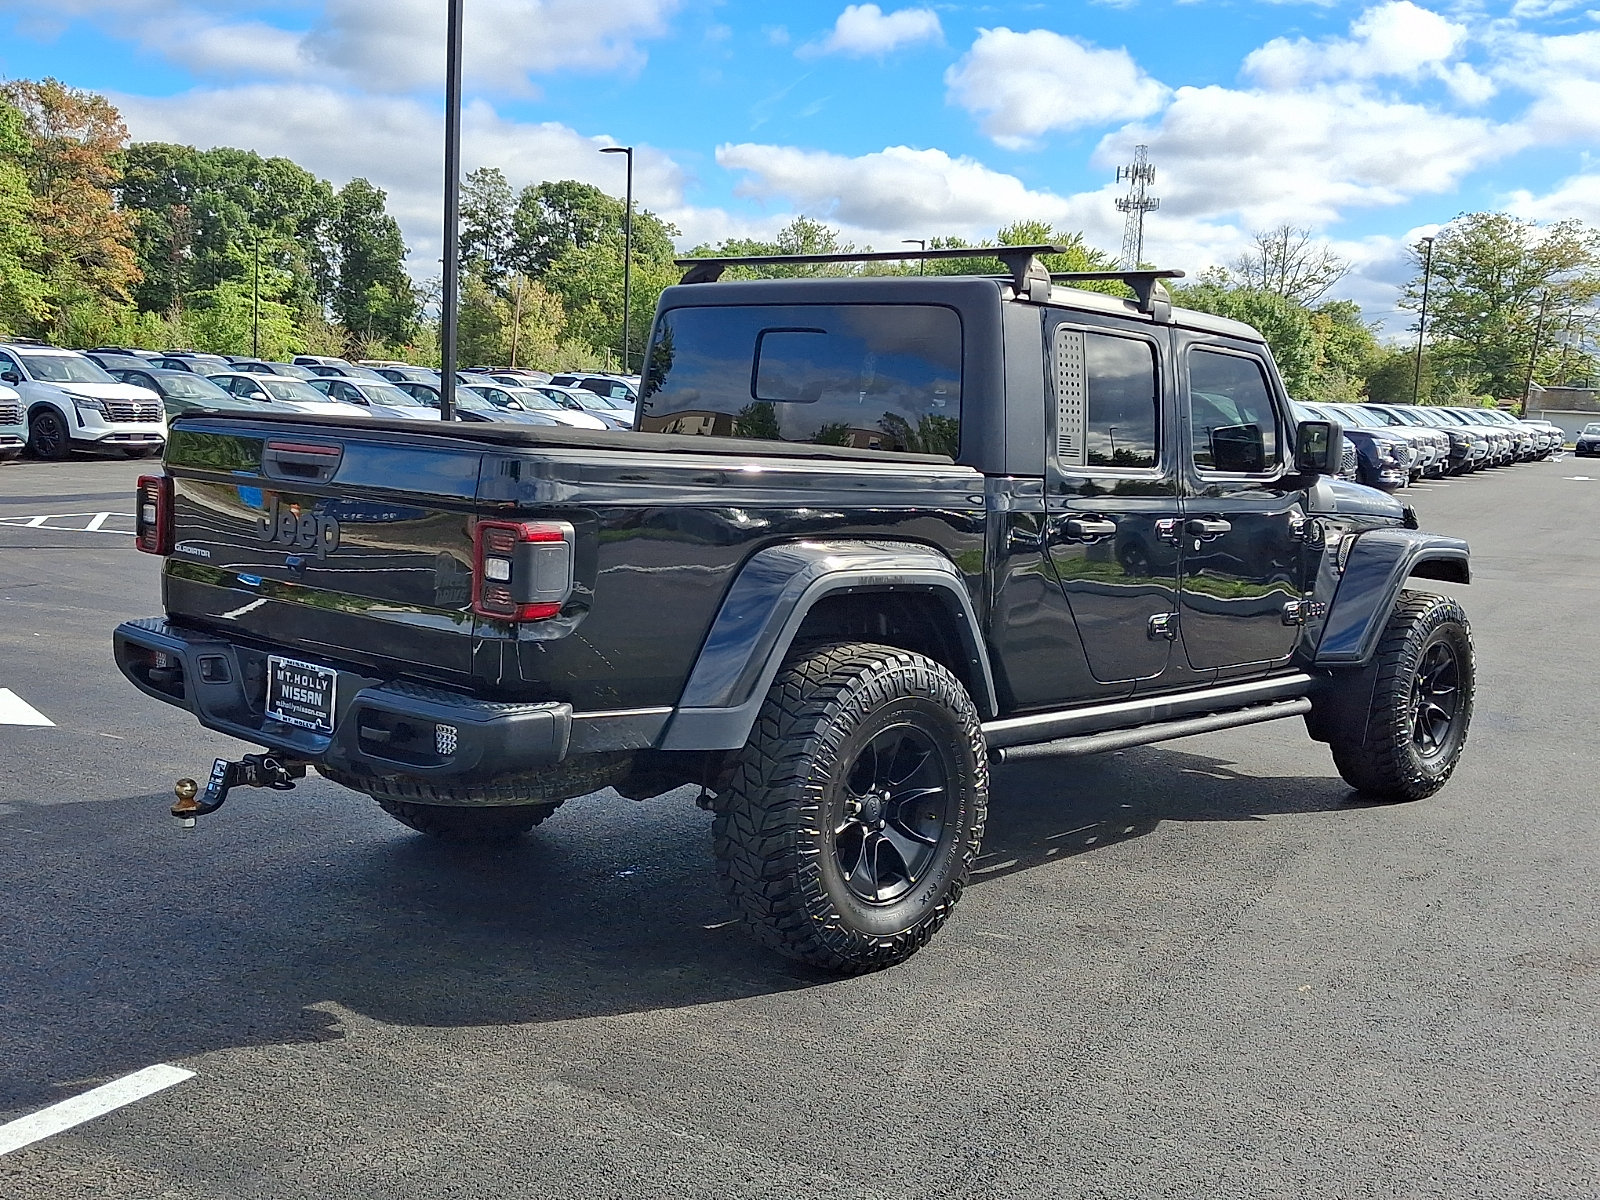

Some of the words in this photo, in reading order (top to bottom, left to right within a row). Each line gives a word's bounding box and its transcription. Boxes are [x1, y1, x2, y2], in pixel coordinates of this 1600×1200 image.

[256, 496, 341, 561] Jeep
[174, 543, 212, 559] GLADIATOR
[281, 684, 322, 706] NISSAN
